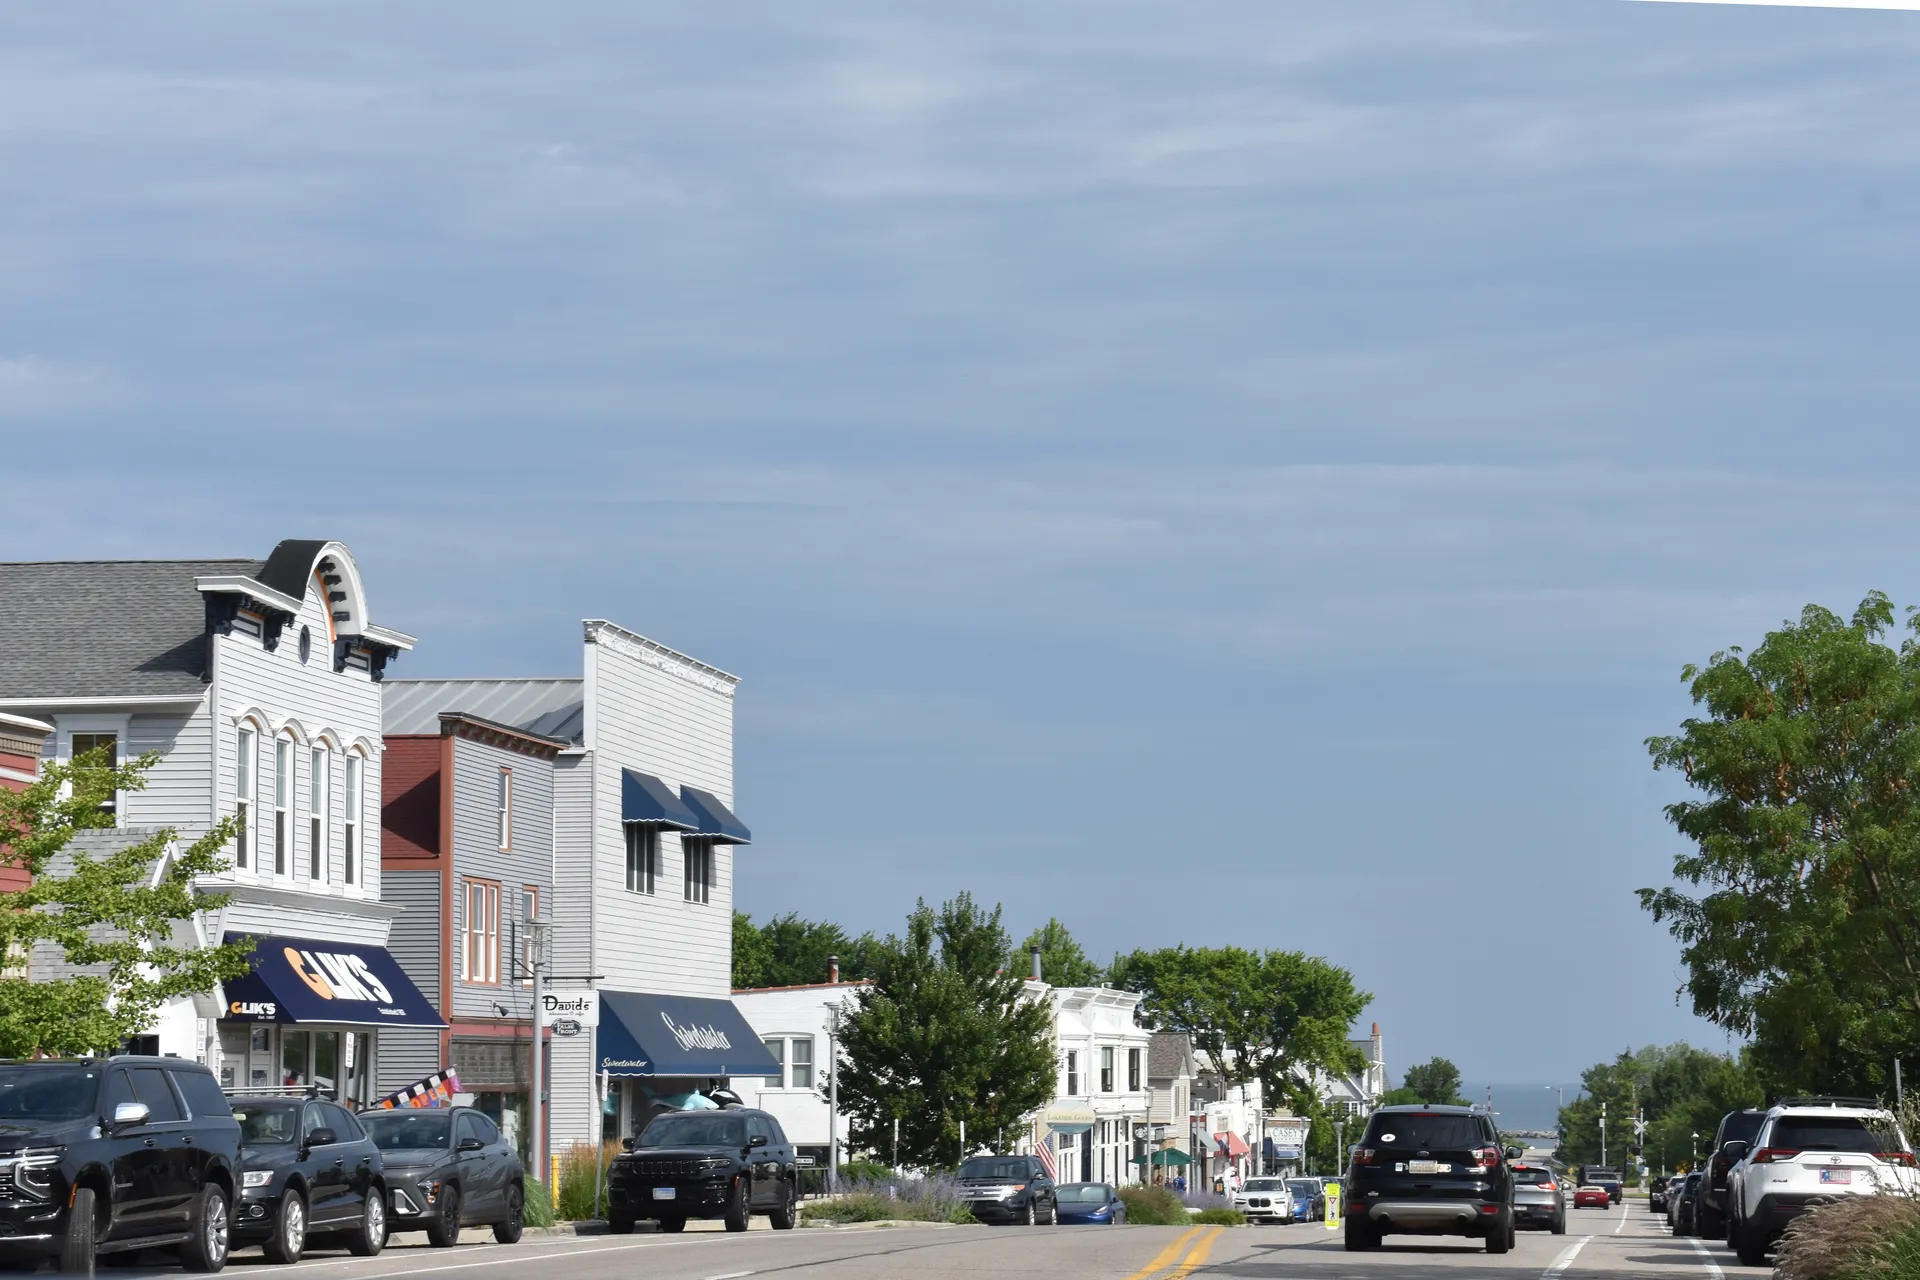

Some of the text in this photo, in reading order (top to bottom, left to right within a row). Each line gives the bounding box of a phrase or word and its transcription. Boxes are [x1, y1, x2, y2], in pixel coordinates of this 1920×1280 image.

[284, 947, 393, 1004] GLIK'S
[231, 1002, 276, 1015] GLIK'S
[542, 995, 592, 1011] David's
[661, 1012, 732, 1051] Sweetwater
[601, 1057, 647, 1068] Sweetwater
